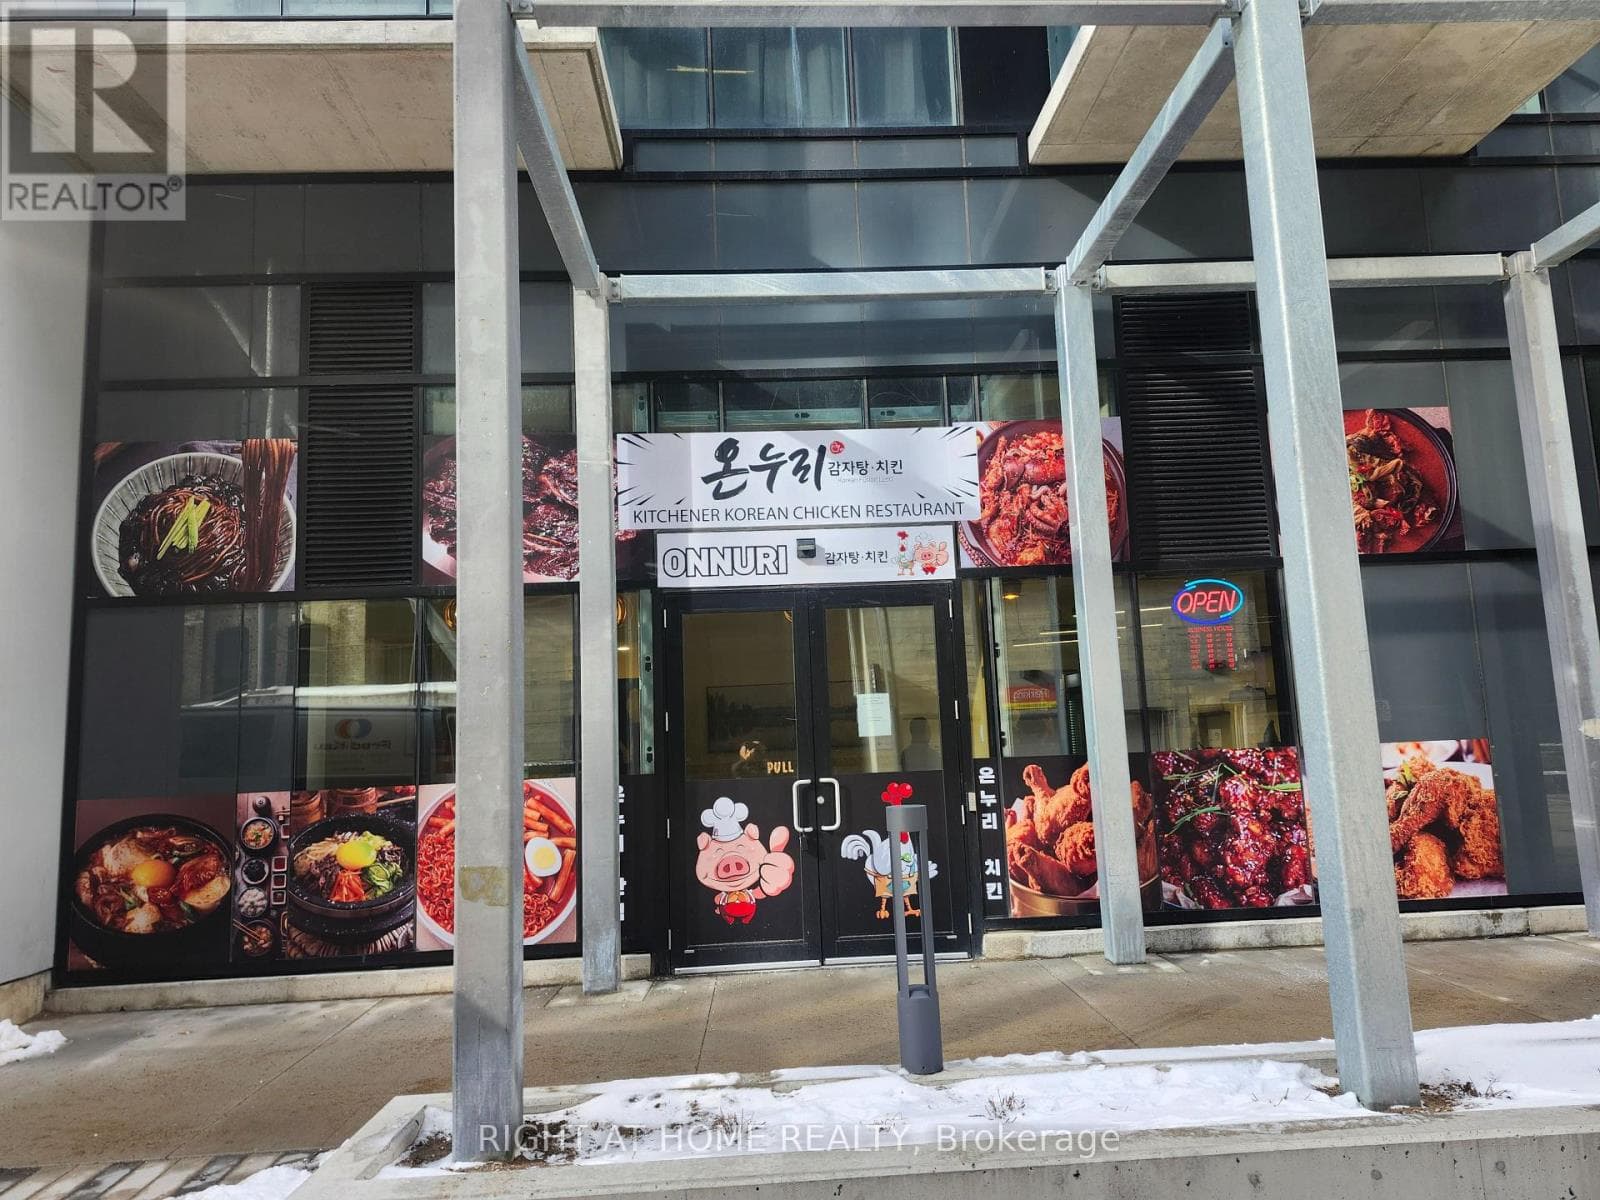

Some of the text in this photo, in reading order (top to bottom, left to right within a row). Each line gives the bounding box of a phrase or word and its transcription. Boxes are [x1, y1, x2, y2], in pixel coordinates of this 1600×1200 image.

[701, 437, 826, 501] 온누리
[633, 501, 965, 524] KITCHENER KOREAN CHICKEN RESTAURANT
[662, 545, 789, 578] ONNURI
[1177, 590, 1236, 613] OPEN
[767, 761, 794, 774] PULL
[978, 766, 1003, 900] 온누리 치킨
